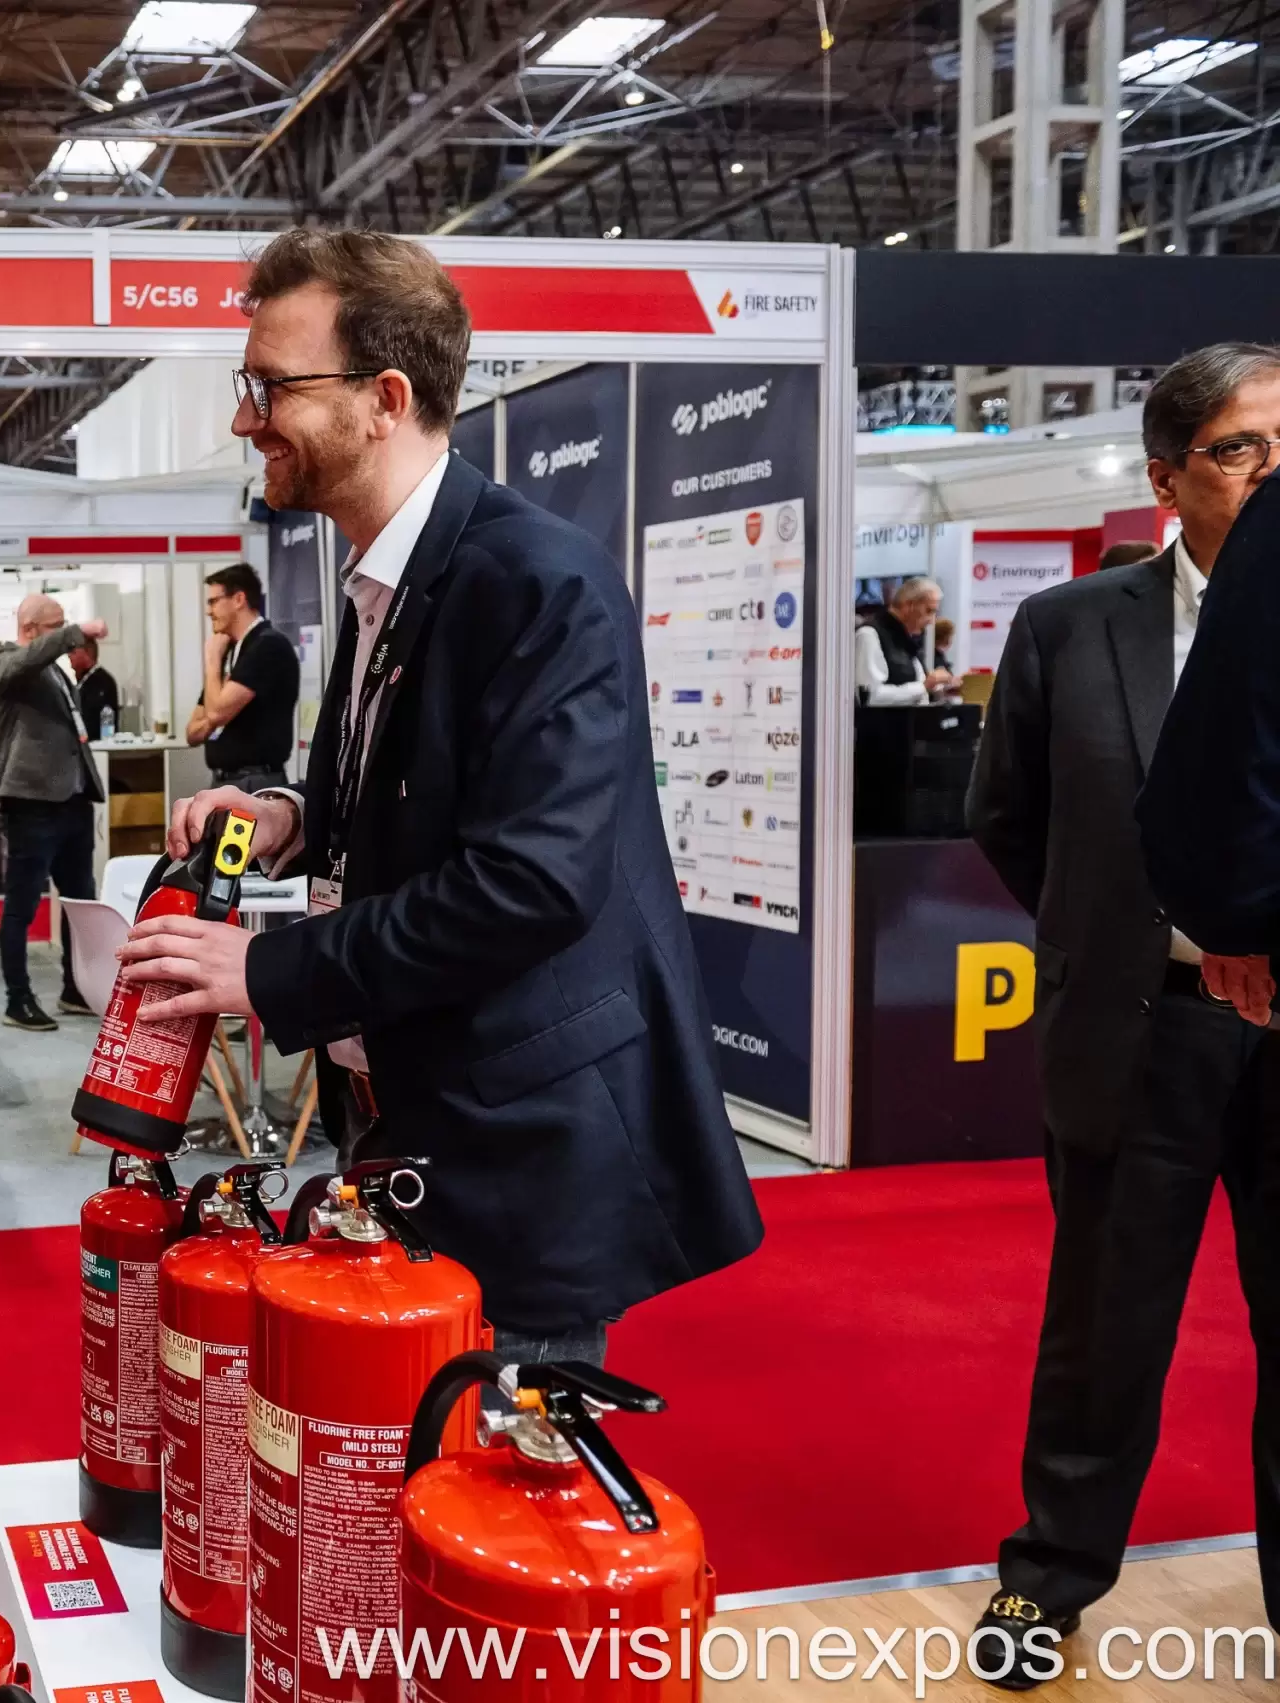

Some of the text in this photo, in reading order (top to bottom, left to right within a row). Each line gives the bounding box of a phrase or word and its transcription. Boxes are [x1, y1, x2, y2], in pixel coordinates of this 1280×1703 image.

[122, 284, 199, 310] 5/C56
[744, 295, 818, 313] FIRE SAFETY
[671, 459, 773, 497] OUR CUSTOMERS
[374, 644, 389, 670] wipro
[172, 1333, 198, 1354] FOAM
[205, 1344, 240, 1357] FLUORINE
[226, 1368, 245, 1377] MODEL
[184, 1398, 200, 1411] BASE
[187, 1407, 200, 1420] THE
[265, 1402, 296, 1437] FOAM
[308, 1421, 404, 1440] FLUORINE FREE FOAM
[342, 1441, 401, 1454] (MILD STEEL)
[304, 1465, 322, 1474] TESTED
[326, 1455, 354, 1468] MODEL
[355, 1459, 370, 1469] NO.
[182, 1477, 195, 1491] LIVE
[172, 1504, 185, 1518] UK
[265, 1492, 297, 1518] THE BASE
[281, 1512, 297, 1529] THE
[285, 1527, 297, 1538] OF
[257, 1565, 264, 1580] B
[262, 1614, 288, 1637] ON LIVE
[261, 1653, 276, 1673] UK
[261, 1667, 277, 1685] CA
